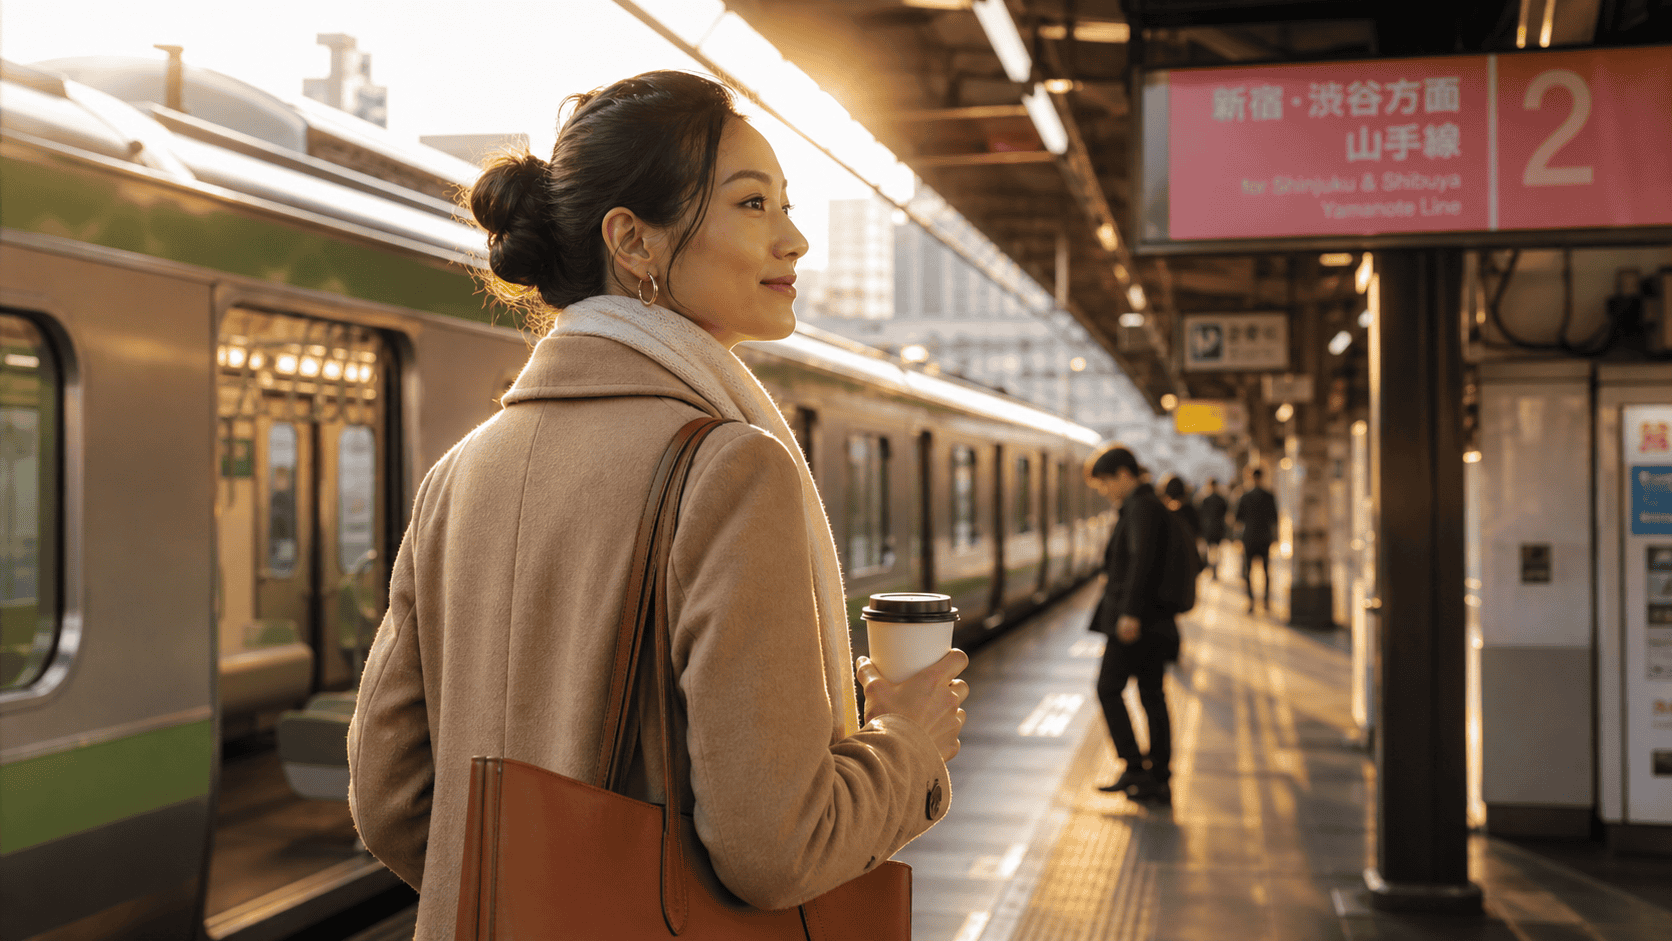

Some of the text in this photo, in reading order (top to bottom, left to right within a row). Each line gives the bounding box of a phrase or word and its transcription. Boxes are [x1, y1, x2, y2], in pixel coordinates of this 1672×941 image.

[1211, 76, 1461, 122] 新宿・渋谷方面
[1346, 123, 1461, 162] 山手線
[1522, 69, 1594, 187] 2
[1241, 172, 1461, 197] for Shinjuku & Shibuya
[1321, 198, 1461, 218] Yamanote Line
